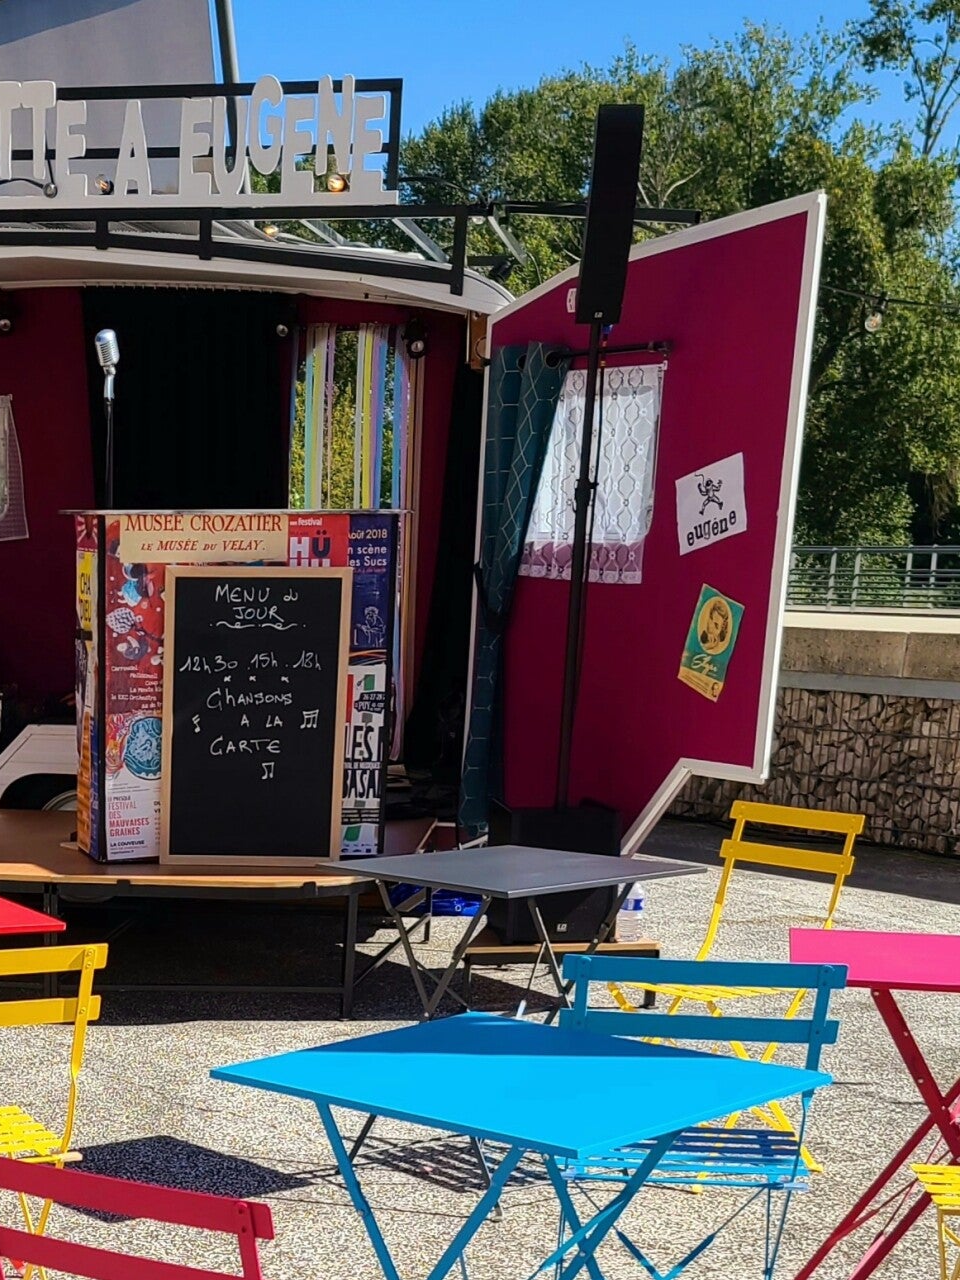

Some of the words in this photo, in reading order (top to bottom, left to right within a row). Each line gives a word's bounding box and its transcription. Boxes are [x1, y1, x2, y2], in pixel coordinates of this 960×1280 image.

[113, 99, 153, 197] A
[179, 73, 388, 196] EUGENE
[190, 514, 283, 534] CROZATIER
[298, 517, 323, 526] festival
[365, 528, 388, 539] 2018
[141, 543, 153, 551] LE
[157, 538, 198, 551] MUSÉE
[203, 543, 218, 551] DU
[289, 529, 331, 559] HÜ
[357, 543, 387, 555] scène
[363, 555, 387, 567] Sucs
[215, 584, 270, 603] MENU
[232, 605, 285, 622] JOUR
[251, 651, 278, 668] 15h
[240, 714, 250, 727] A
[265, 715, 283, 728] LA
[209, 735, 281, 756] CARTE
[108, 801, 137, 811] FESTIVAL
[109, 810, 122, 820] DES
[109, 818, 150, 828] MAUVAISES
[109, 827, 141, 837] GRAINES
